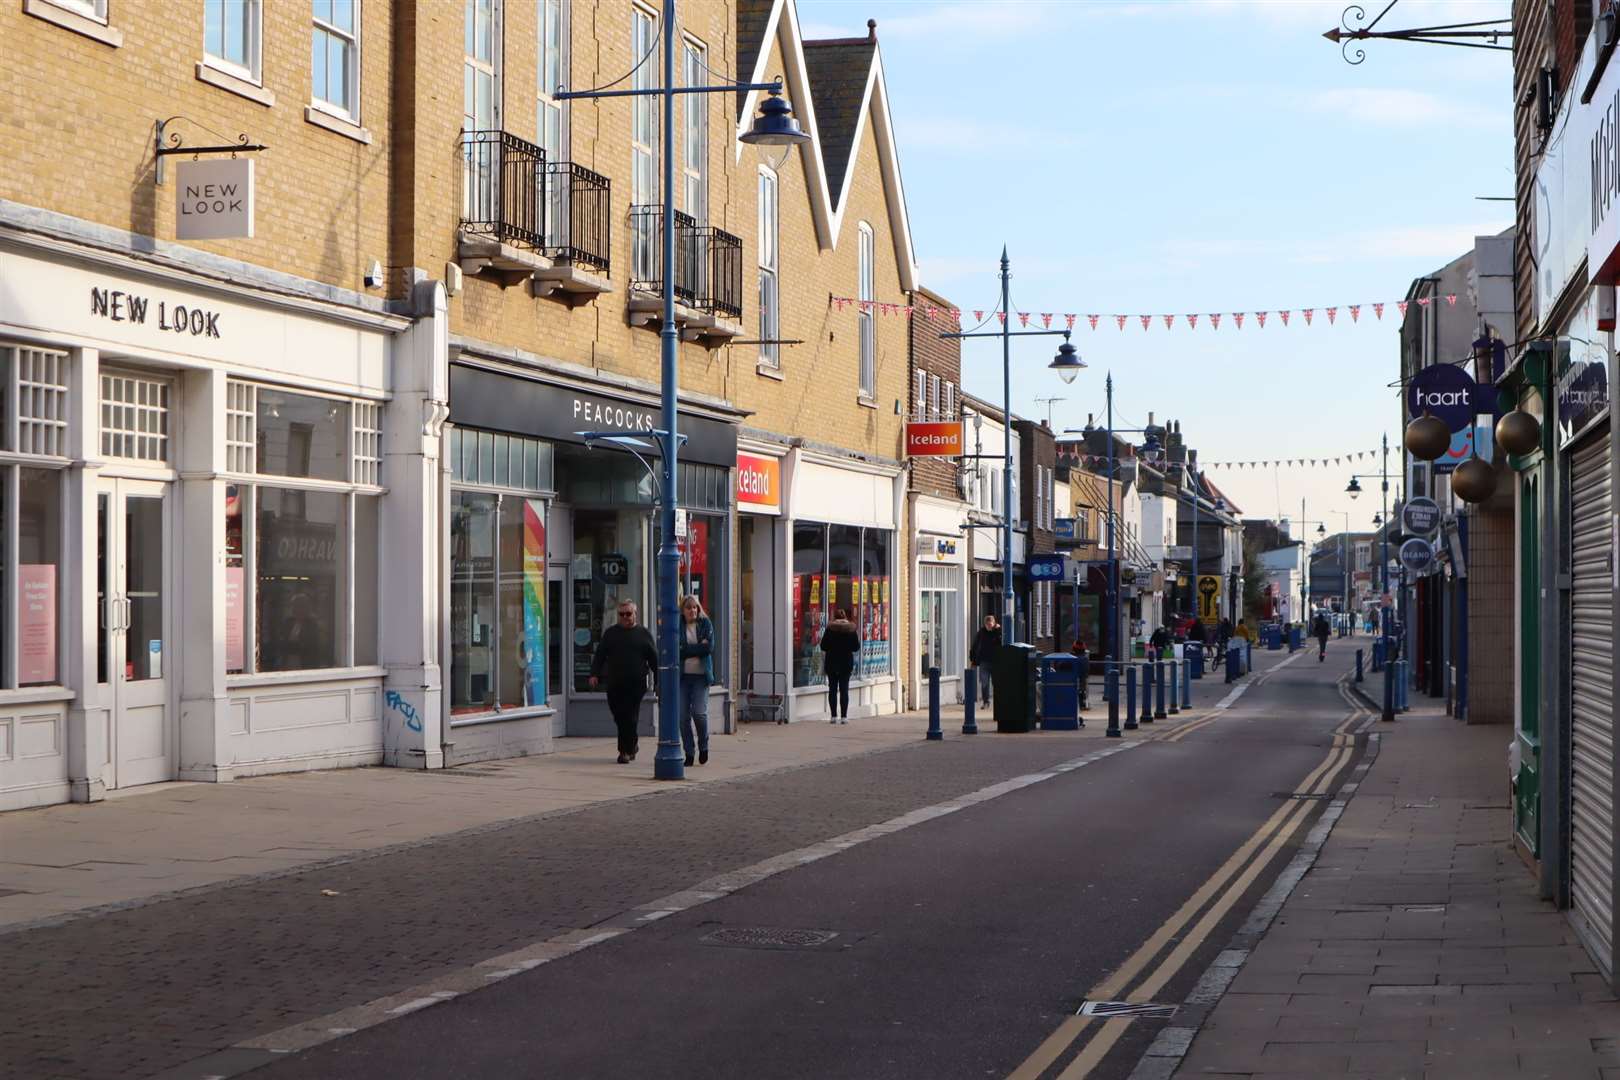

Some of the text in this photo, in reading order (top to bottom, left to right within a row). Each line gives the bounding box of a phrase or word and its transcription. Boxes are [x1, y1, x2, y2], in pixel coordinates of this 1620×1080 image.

[186, 184, 237, 198] NEW
[182, 199, 242, 215] LOOK
[91, 287, 220, 338] NEW LOOK
[1416, 387, 1469, 405] haart
[573, 400, 653, 432] PEACOCKS
